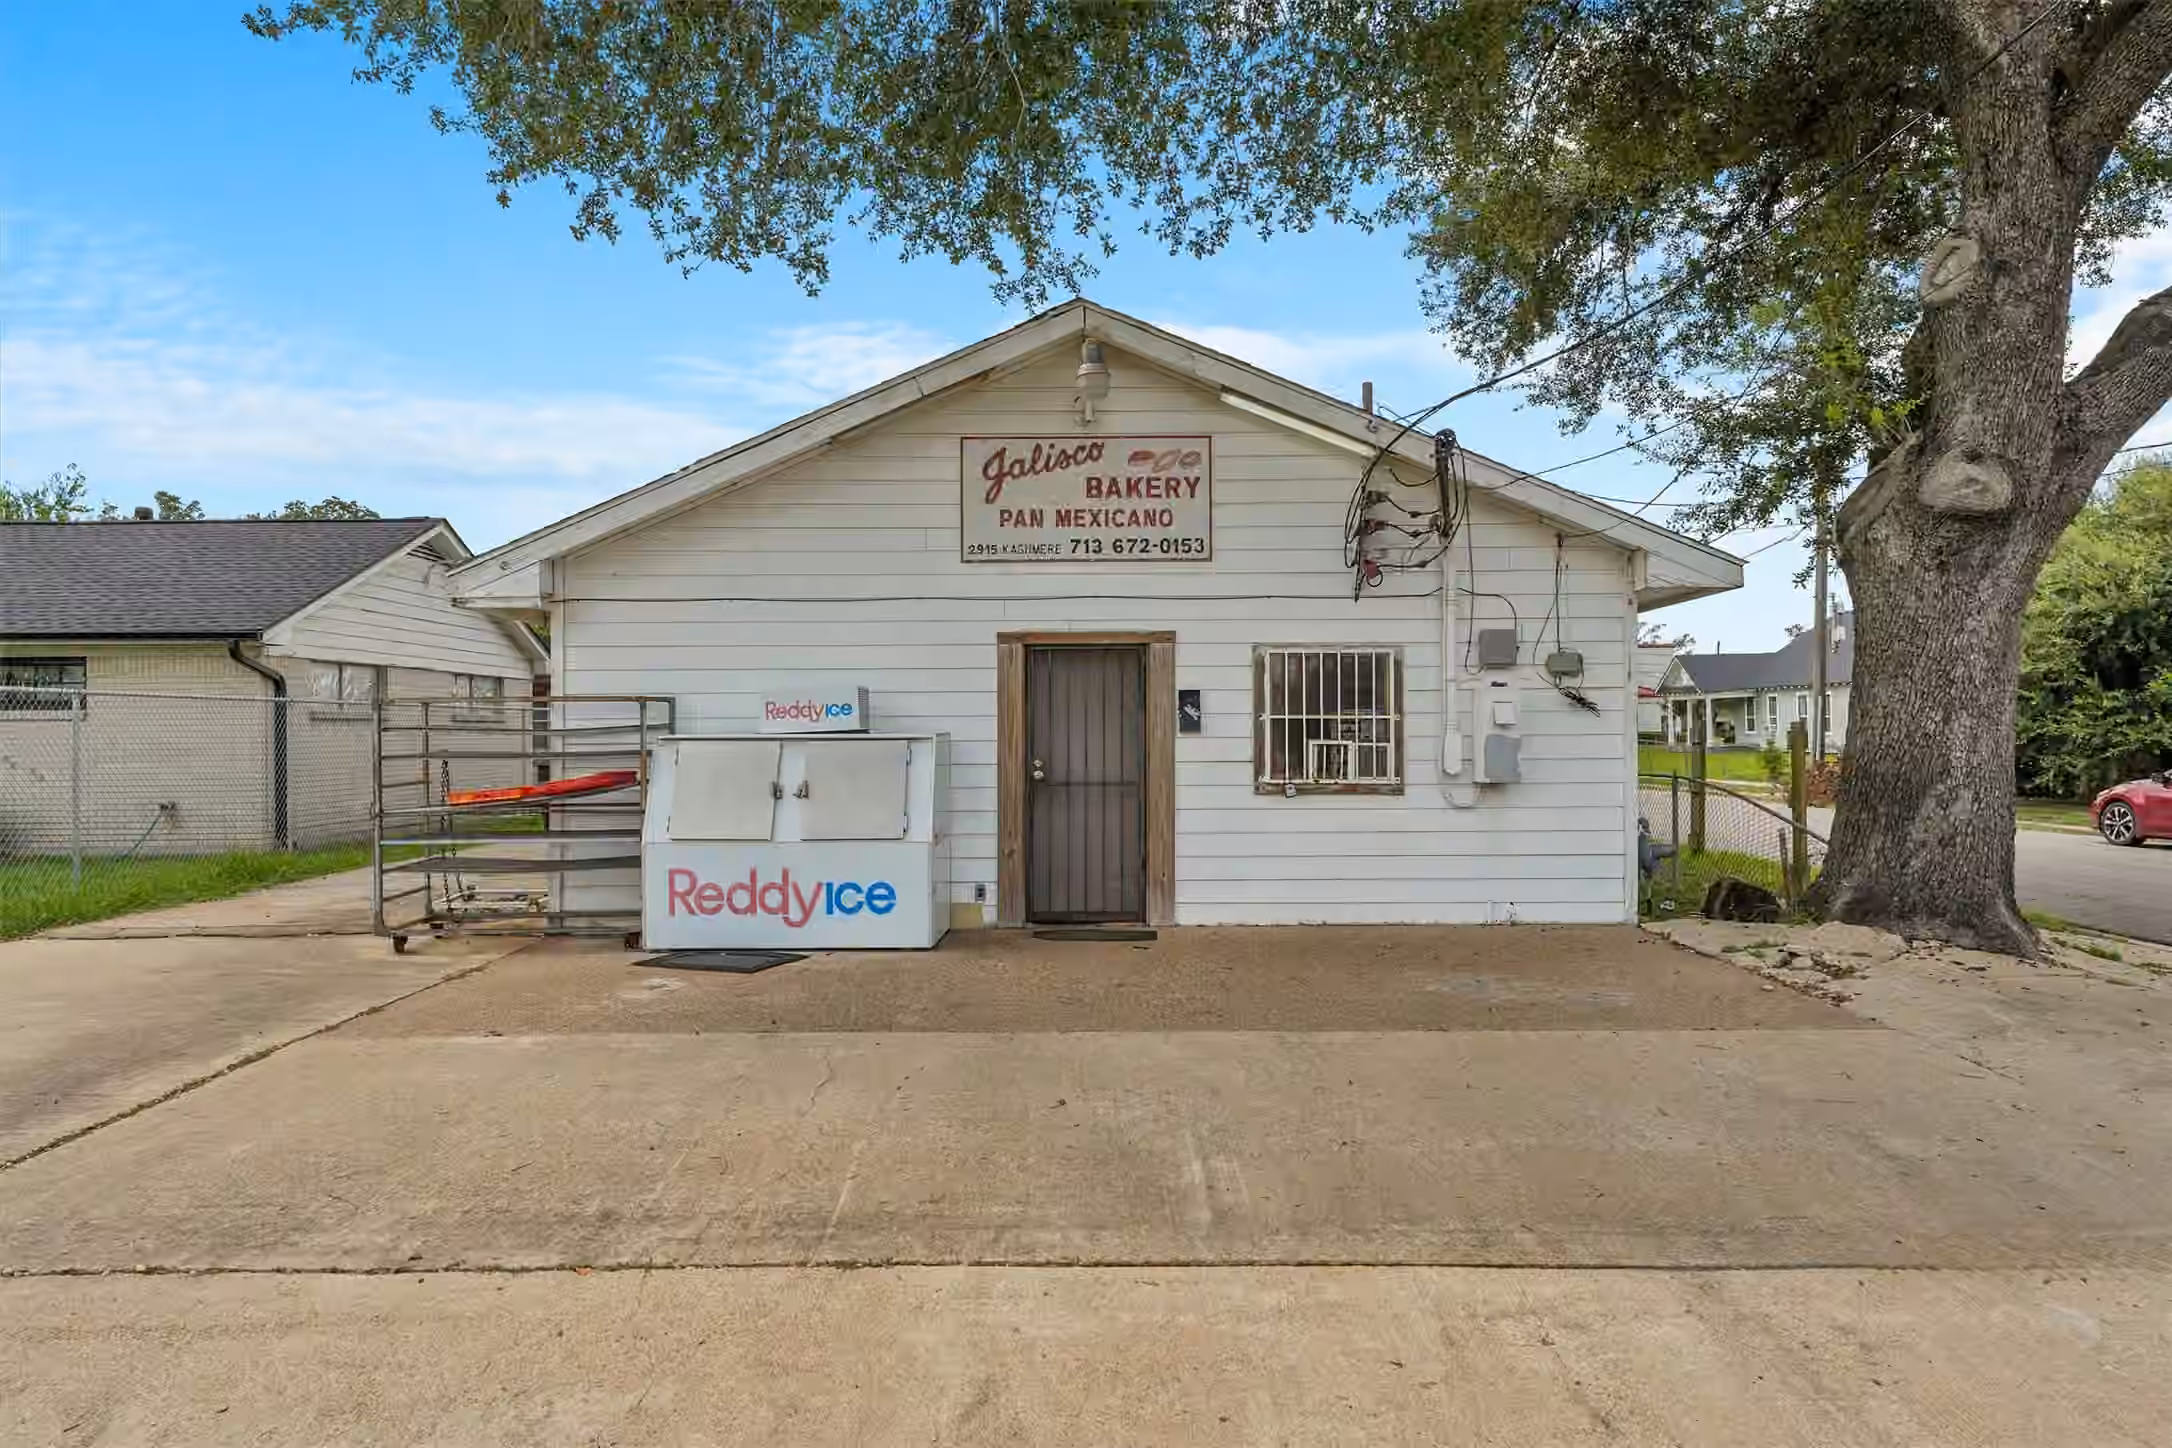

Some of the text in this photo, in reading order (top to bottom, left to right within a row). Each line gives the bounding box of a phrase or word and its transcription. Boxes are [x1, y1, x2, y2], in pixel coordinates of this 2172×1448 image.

[982, 441, 1105, 504] Jalisco
[1085, 476, 1201, 499] BAKERY
[999, 508, 1174, 528] PAN MEXICANO
[1070, 538, 1103, 554] 713
[1112, 538, 1205, 554] 672-0153
